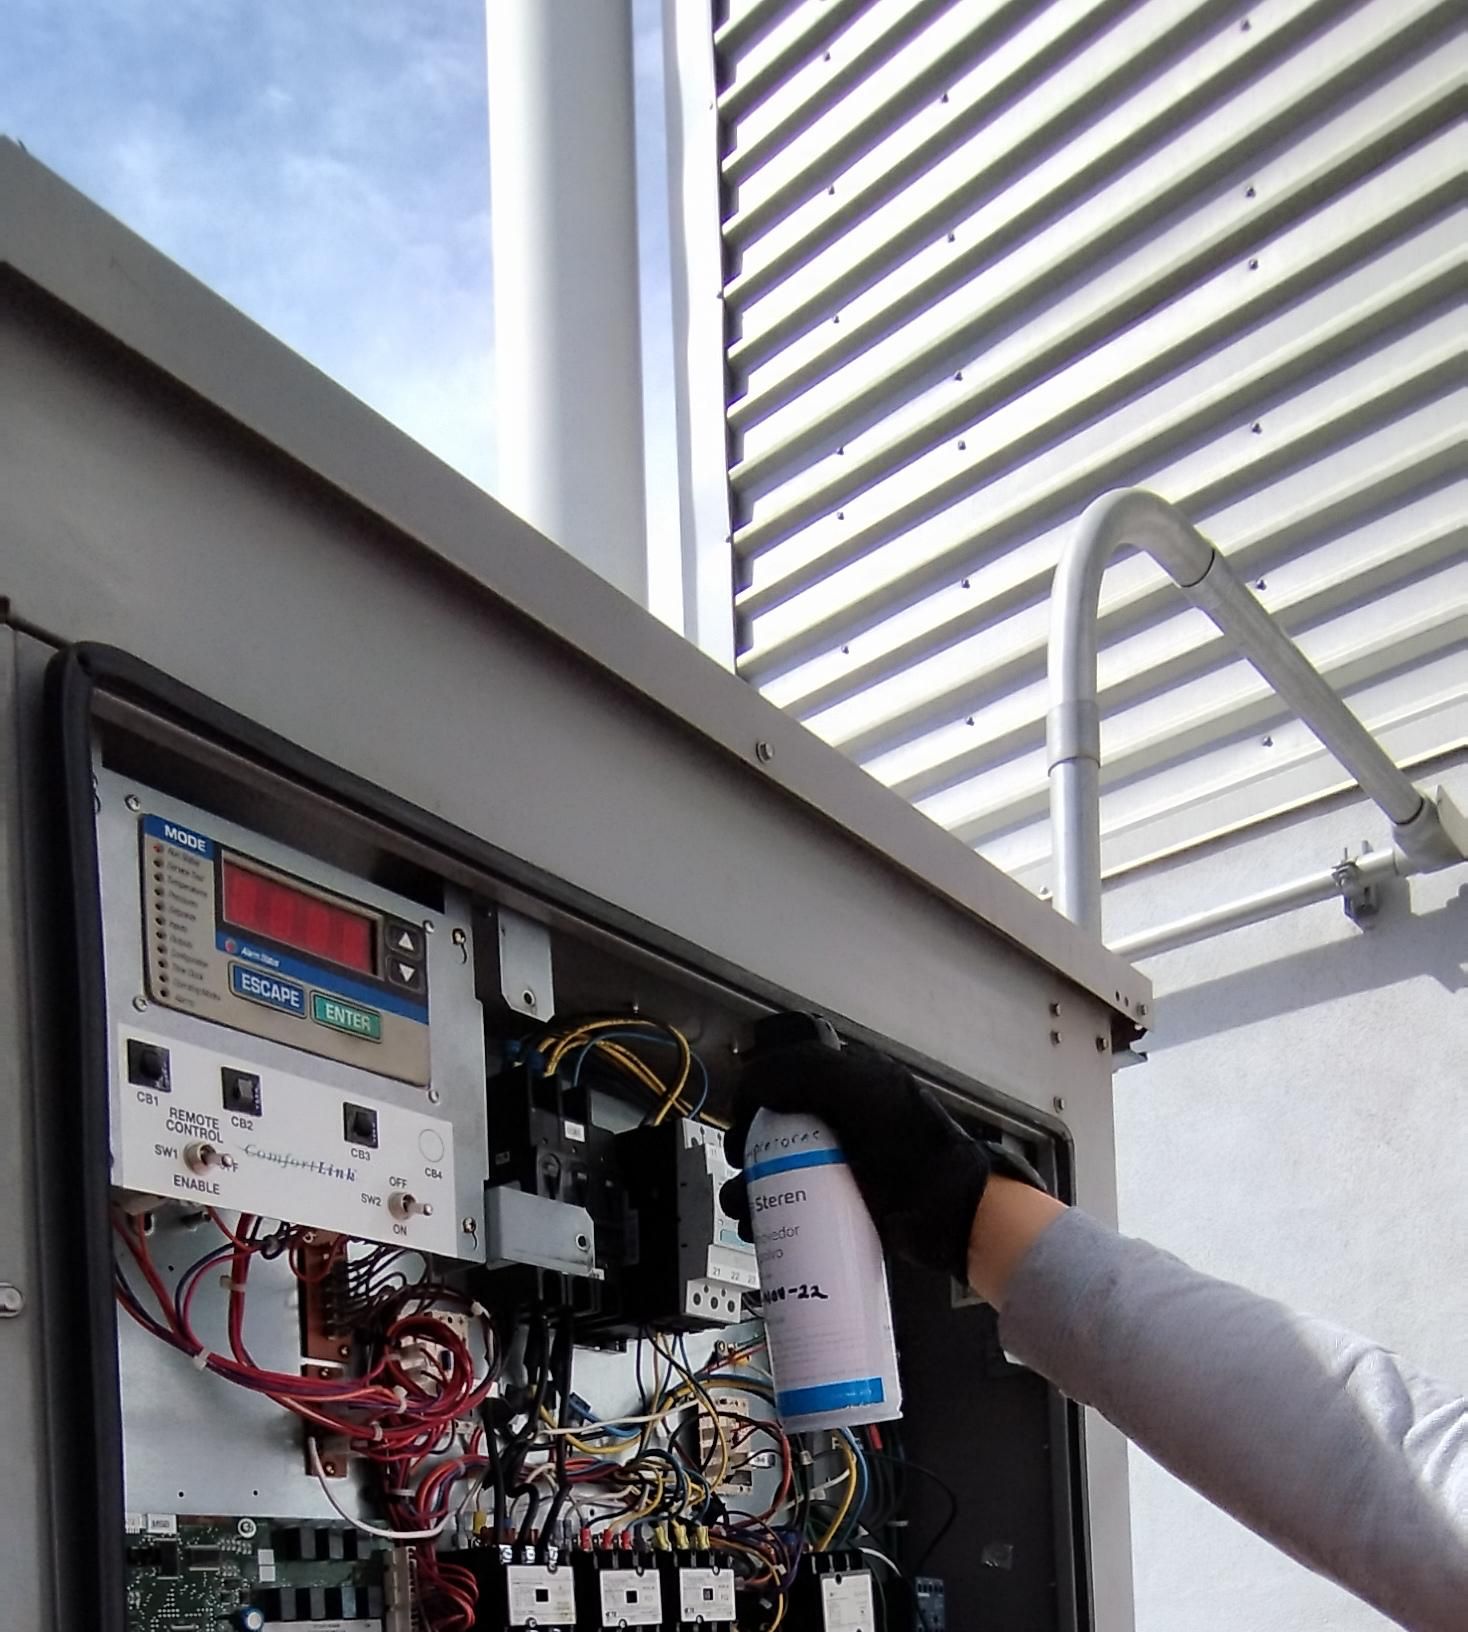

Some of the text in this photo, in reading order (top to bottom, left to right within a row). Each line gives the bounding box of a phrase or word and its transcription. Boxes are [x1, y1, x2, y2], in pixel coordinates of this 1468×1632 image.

[164, 824, 206, 852] MODE
[241, 972, 300, 1008] ESCAPE
[325, 1003, 371, 1032] ENTER
[137, 1091, 159, 1106] CB1
[169, 1107, 219, 1130] REMOTE
[231, 1116, 254, 1131] CB2
[166, 1119, 224, 1144] CONTROL
[154, 1144, 178, 1159] SW1
[350, 1148, 371, 1161] CB3
[240, 1143, 357, 1182] ComfortLink
[389, 1176, 408, 1189] OFF
[424, 1167, 443, 1180] CB4
[173, 1174, 220, 1195] ENABLE
[361, 1193, 382, 1207] SW2
[755, 1189, 807, 1212] Steren
[393, 1223, 408, 1236] ON
